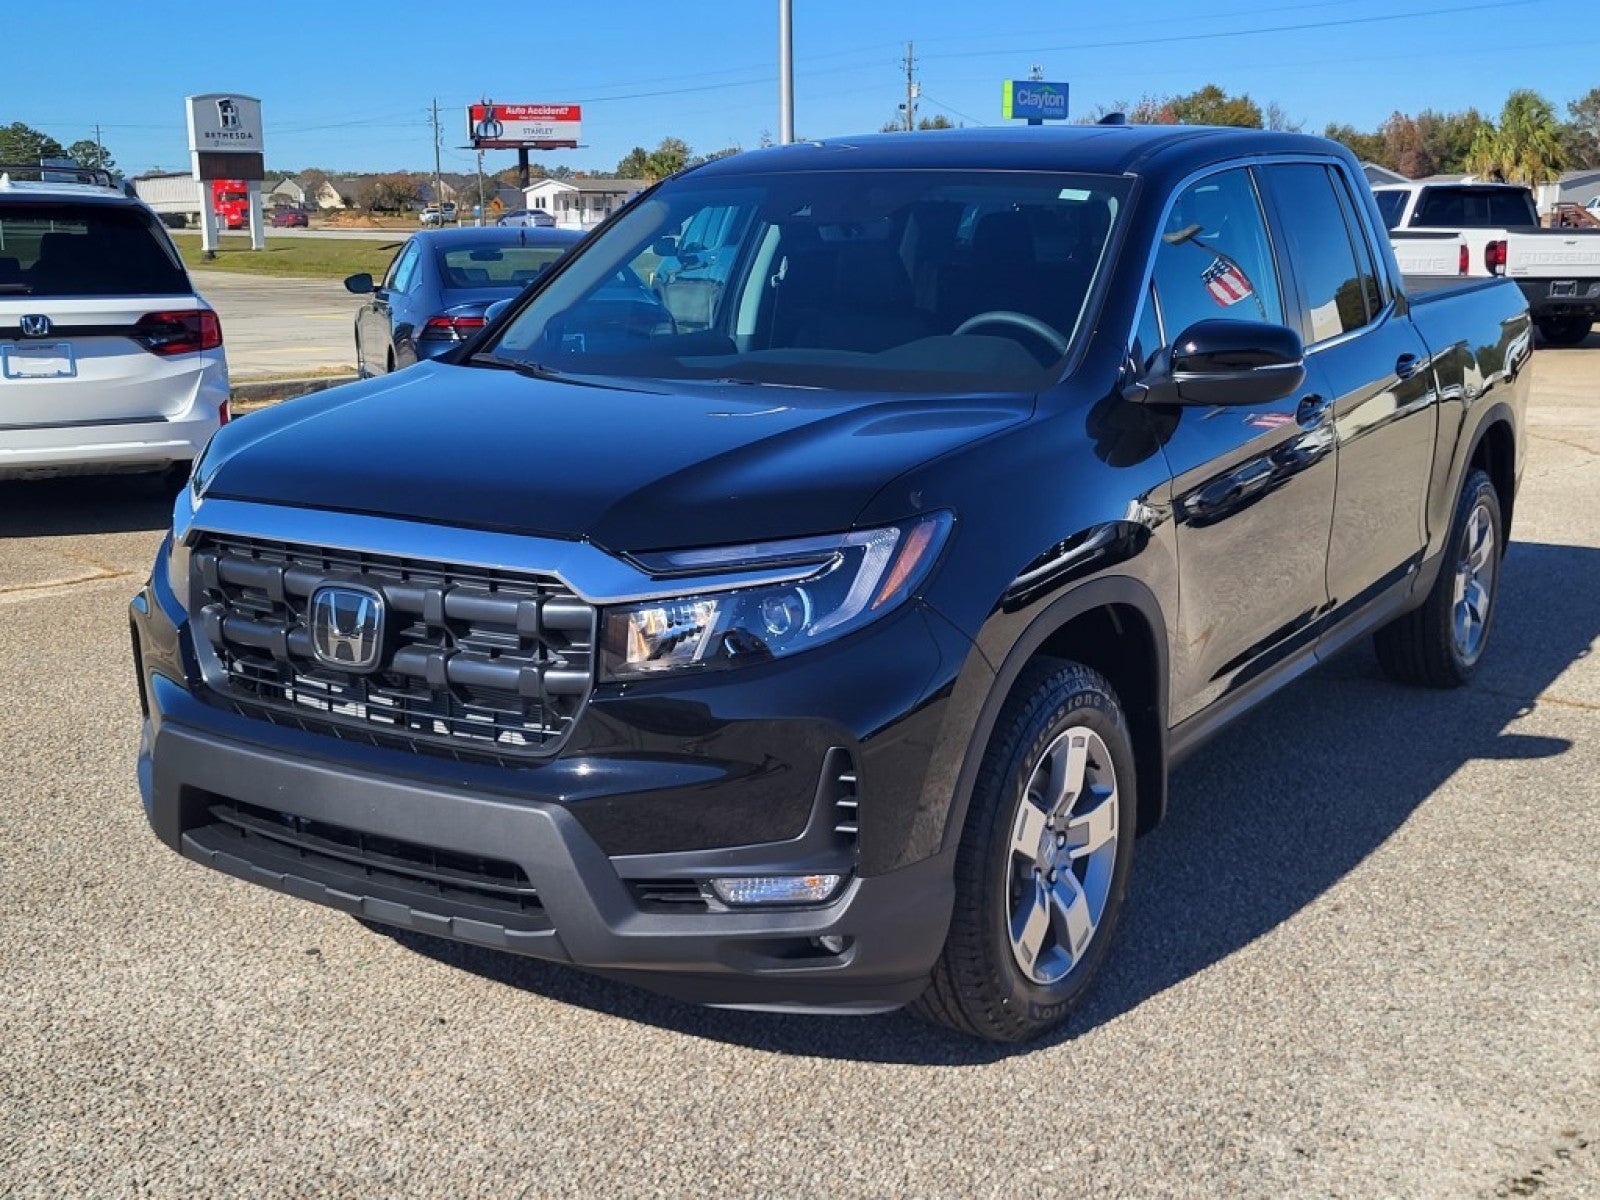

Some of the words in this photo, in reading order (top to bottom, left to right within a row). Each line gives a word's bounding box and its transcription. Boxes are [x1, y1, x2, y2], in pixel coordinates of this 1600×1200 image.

[1017, 89, 1064, 108] Clayton
[506, 105, 525, 114] Auto
[527, 104, 569, 114] Accident?
[523, 127, 553, 135] STANLEY
[204, 132, 254, 140] BETHESDA
